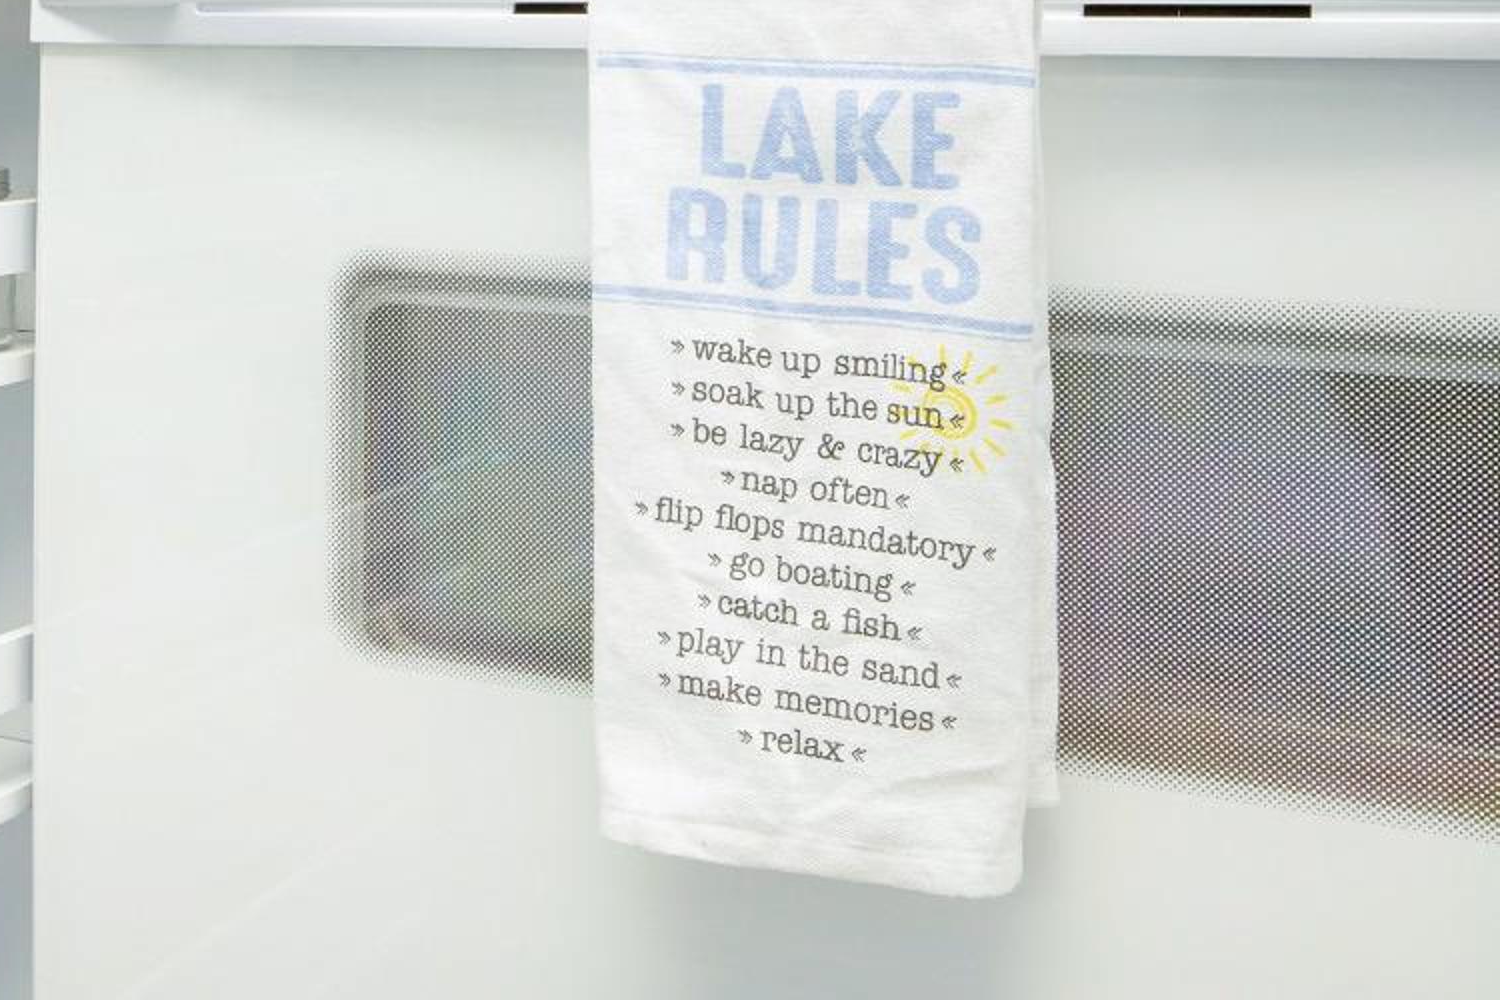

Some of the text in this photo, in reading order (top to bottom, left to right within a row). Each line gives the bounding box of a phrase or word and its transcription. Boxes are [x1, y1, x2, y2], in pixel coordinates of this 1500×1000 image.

[702, 82, 961, 190] LAKE
[666, 186, 982, 305] RULES
[692, 337, 946, 392] wake up smiling
[692, 381, 944, 429] soak up the sun
[693, 418, 942, 478] be lazy & crazy
[741, 470, 889, 509] nap often
[655, 497, 975, 569] flip flops mandatory
[729, 552, 893, 602] go boating
[717, 593, 901, 641] catch a fish
[676, 628, 941, 689] play in the sand
[677, 672, 935, 732] make memories
[761, 729, 845, 762] relax
